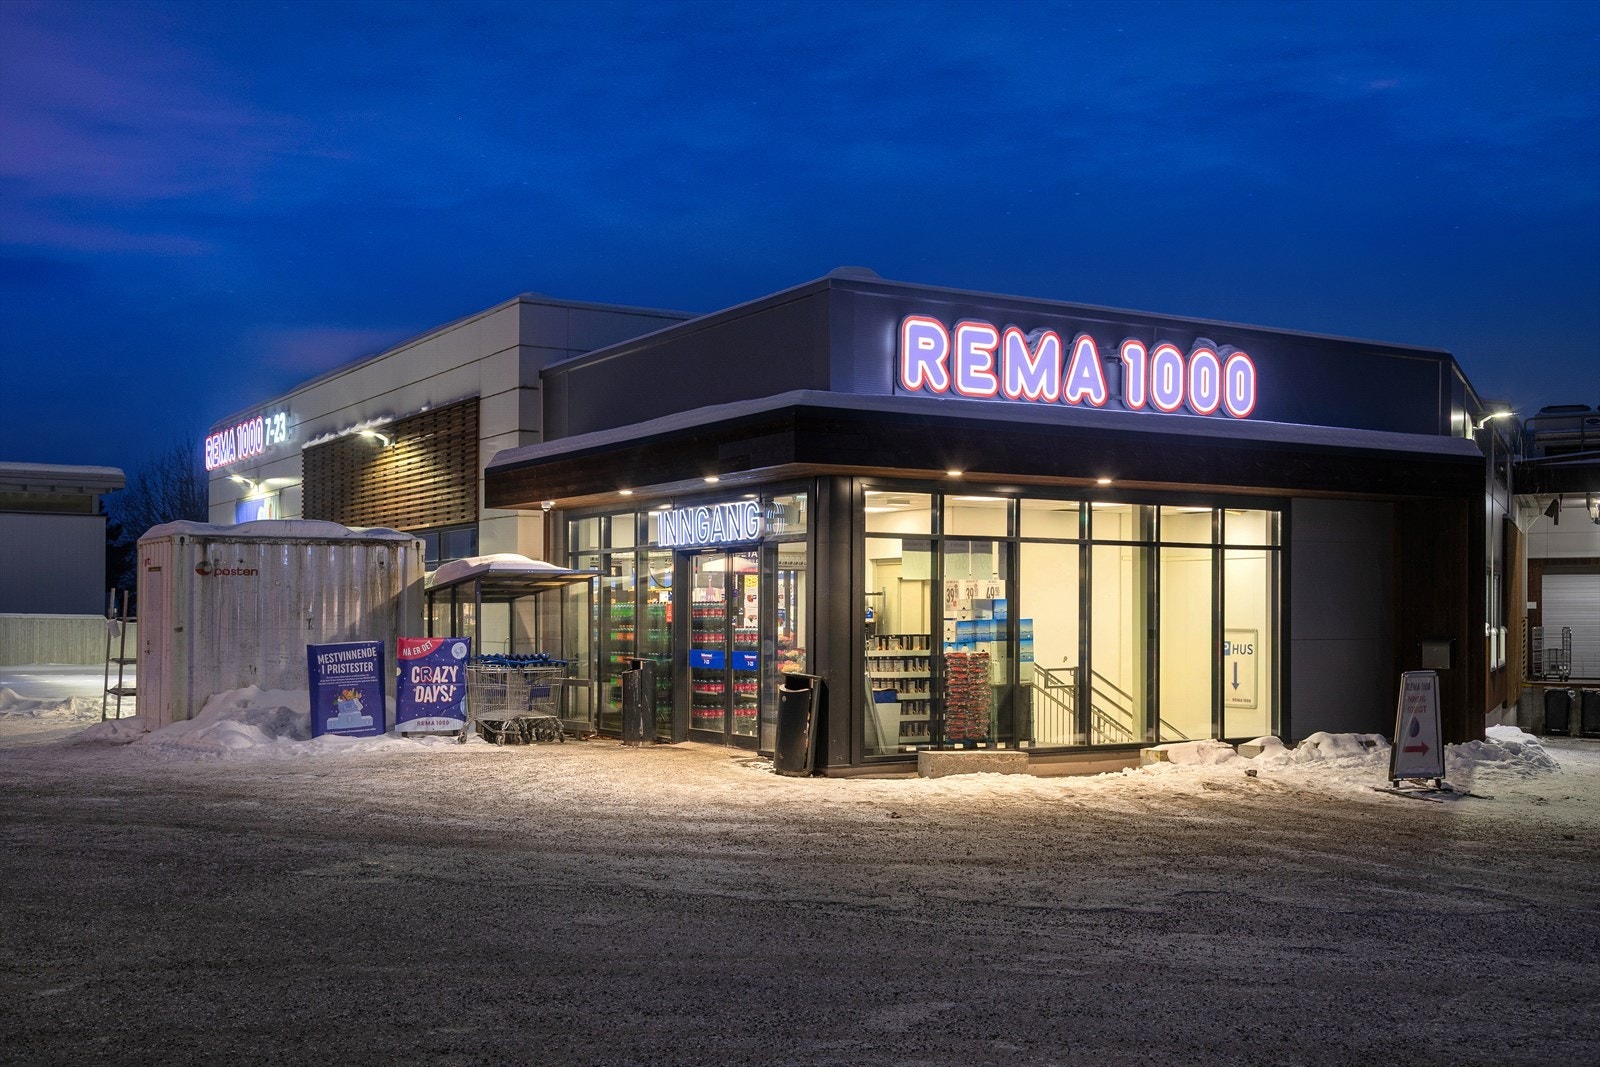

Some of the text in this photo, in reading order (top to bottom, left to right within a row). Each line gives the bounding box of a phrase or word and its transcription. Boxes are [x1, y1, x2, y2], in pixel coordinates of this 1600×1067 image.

[899, 314, 1256, 418] REMA 1000
[205, 412, 286, 471] REMA 1000 7-23
[656, 500, 760, 547] INNGANG
[214, 567, 259, 577] posten
[317, 647, 377, 665] MESTVINNENDE
[402, 641, 433, 656] NÅ ER DET
[1232, 644, 1254, 655] HUS
[321, 662, 374, 675] I PRISTESTER
[411, 665, 459, 684] CRAZY
[414, 684, 454, 703] DAYS!
